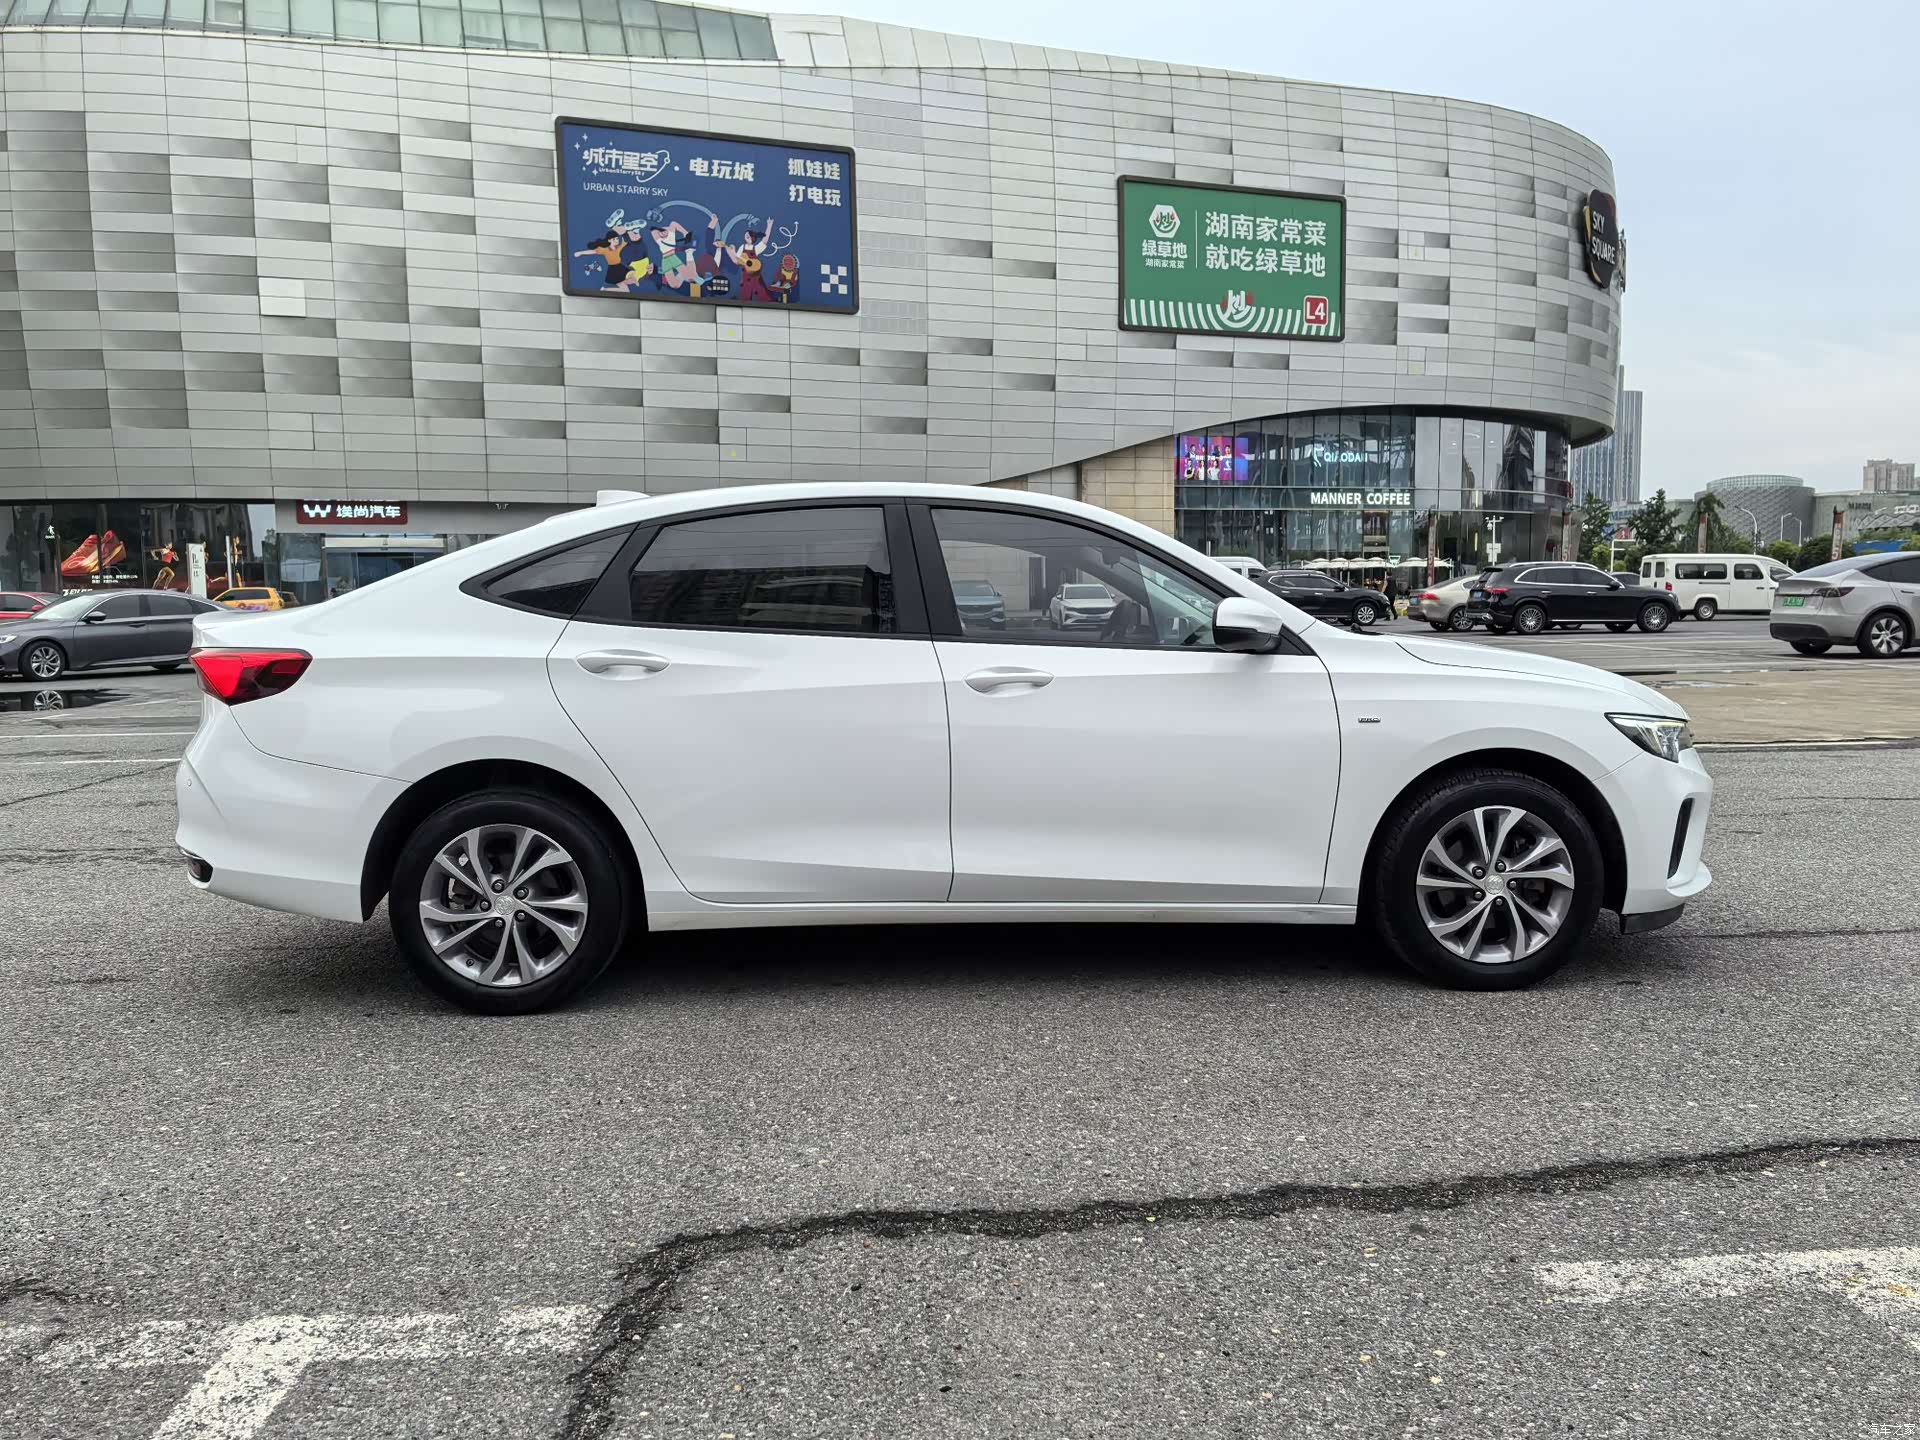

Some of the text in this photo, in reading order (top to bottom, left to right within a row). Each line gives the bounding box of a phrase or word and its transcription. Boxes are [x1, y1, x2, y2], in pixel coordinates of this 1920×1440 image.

[689, 157, 754, 181] 电玩城
[788, 158, 841, 180] 抓娃娃
[583, 182, 669, 197] URBAN STARRY SKY
[789, 184, 841, 206] 打电玩
[1205, 211, 1327, 246] 湖南家常菜
[1592, 211, 1605, 233] SKY
[1142, 239, 1188, 258] 绿草地
[1205, 243, 1327, 278] 就吃绿草地
[1306, 301, 1326, 321] L4
[1310, 492, 1411, 506] MANNER COFFEE
[336, 504, 401, 518] 埃尚汽车
